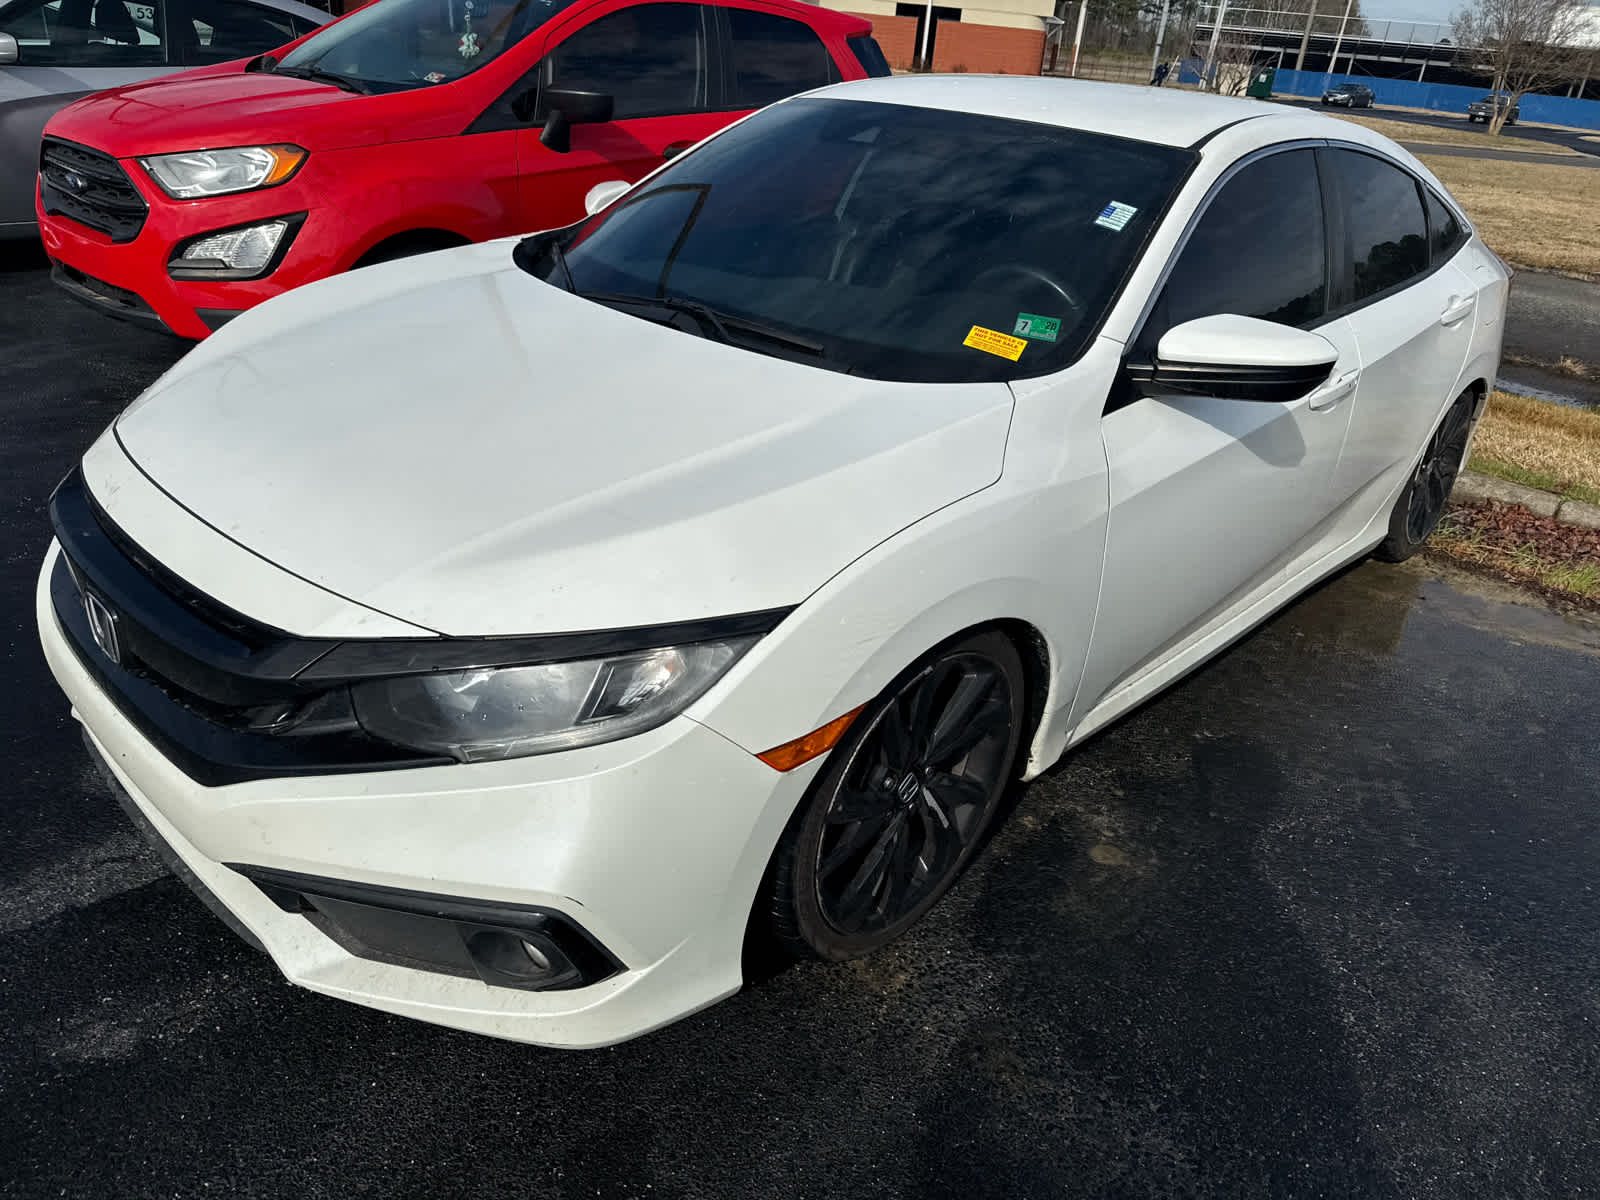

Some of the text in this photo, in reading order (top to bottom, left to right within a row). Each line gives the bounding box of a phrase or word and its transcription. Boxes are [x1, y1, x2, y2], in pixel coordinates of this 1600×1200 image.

[1021, 321, 1029, 331] 7
[990, 331, 1017, 343] VEHICLE
[1002, 341, 1018, 349] SALE
